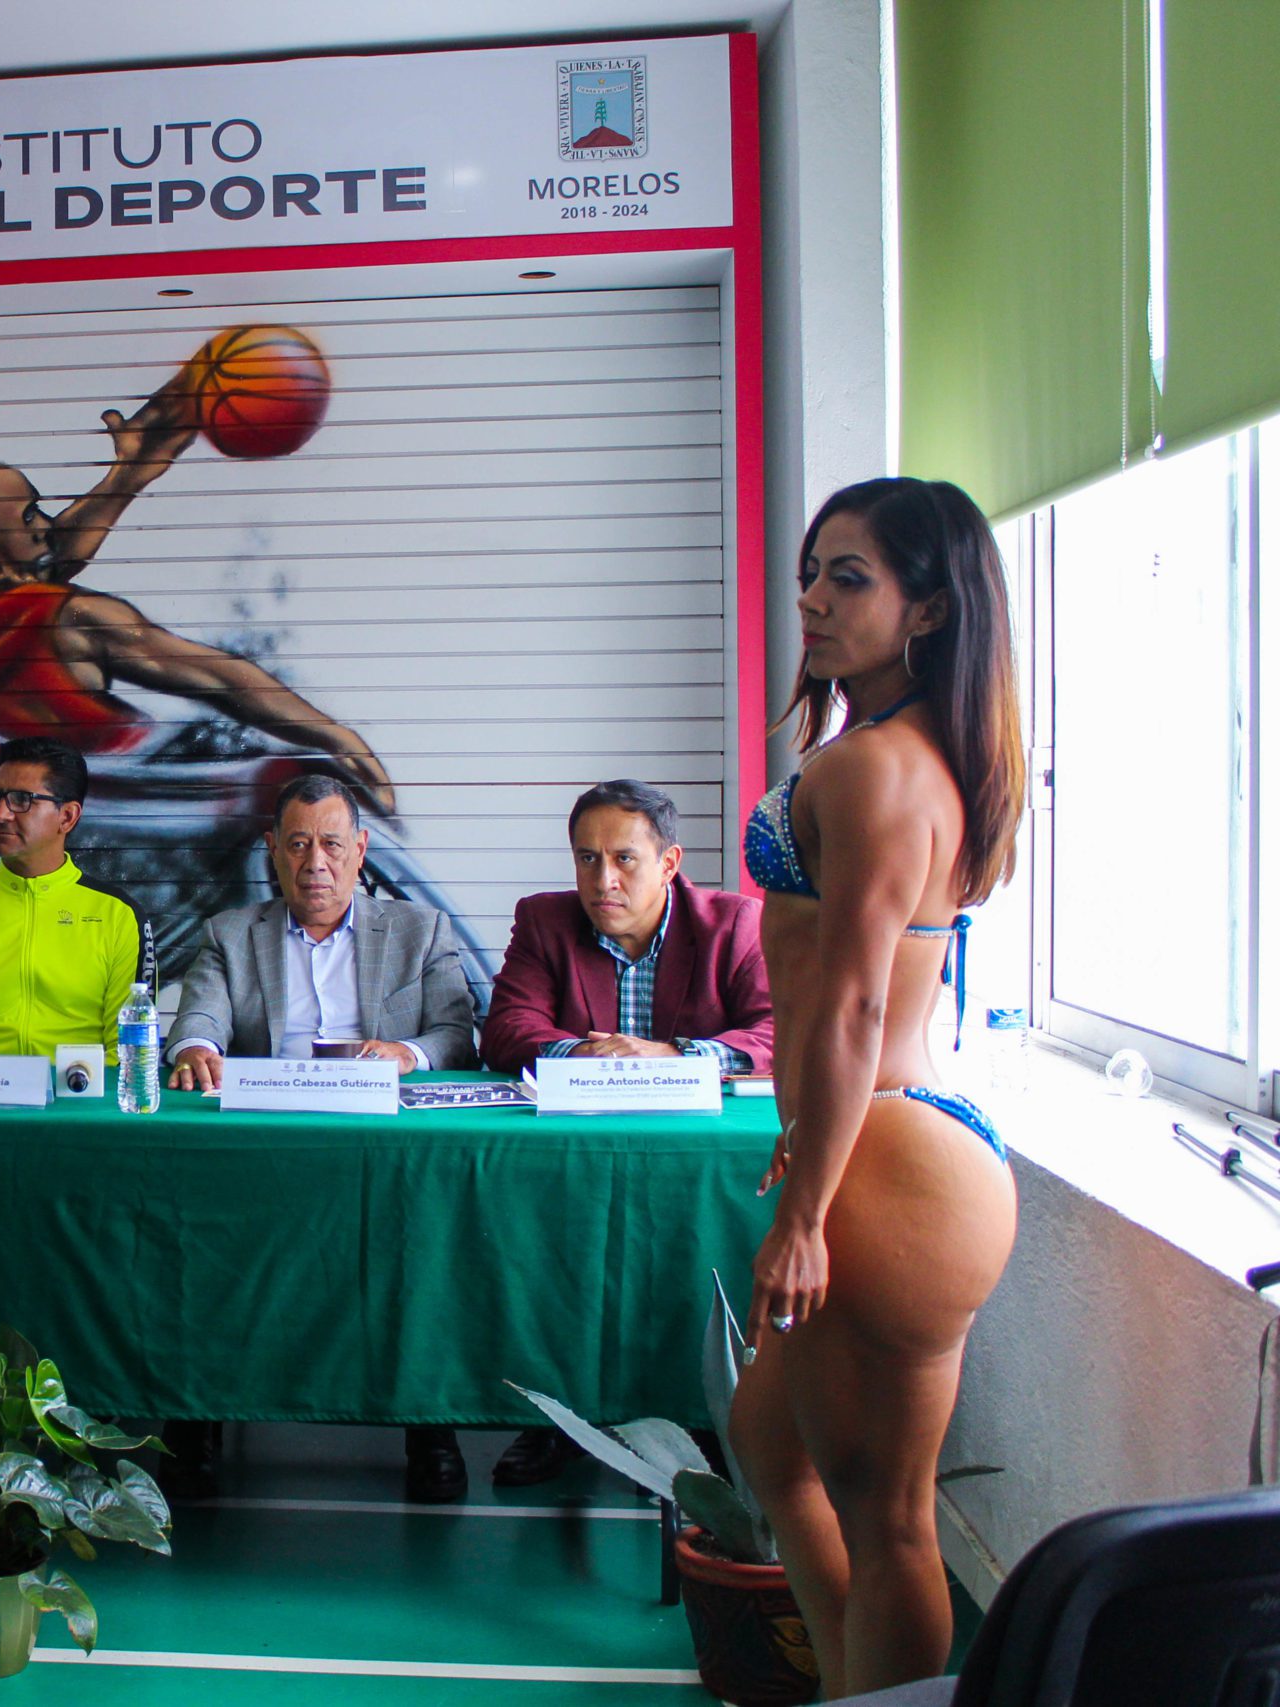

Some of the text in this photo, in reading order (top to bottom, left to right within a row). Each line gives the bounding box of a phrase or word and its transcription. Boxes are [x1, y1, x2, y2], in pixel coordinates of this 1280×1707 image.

[528, 172, 680, 200] MORELOS
[54, 166, 427, 229] DEPORTE
[560, 206, 597, 219] 2018
[612, 204, 649, 217] 2024
[239, 1078, 392, 1088] Francisco Cabezas Gutiérrez
[569, 1076, 700, 1086] Marco Antonio Cabezas
